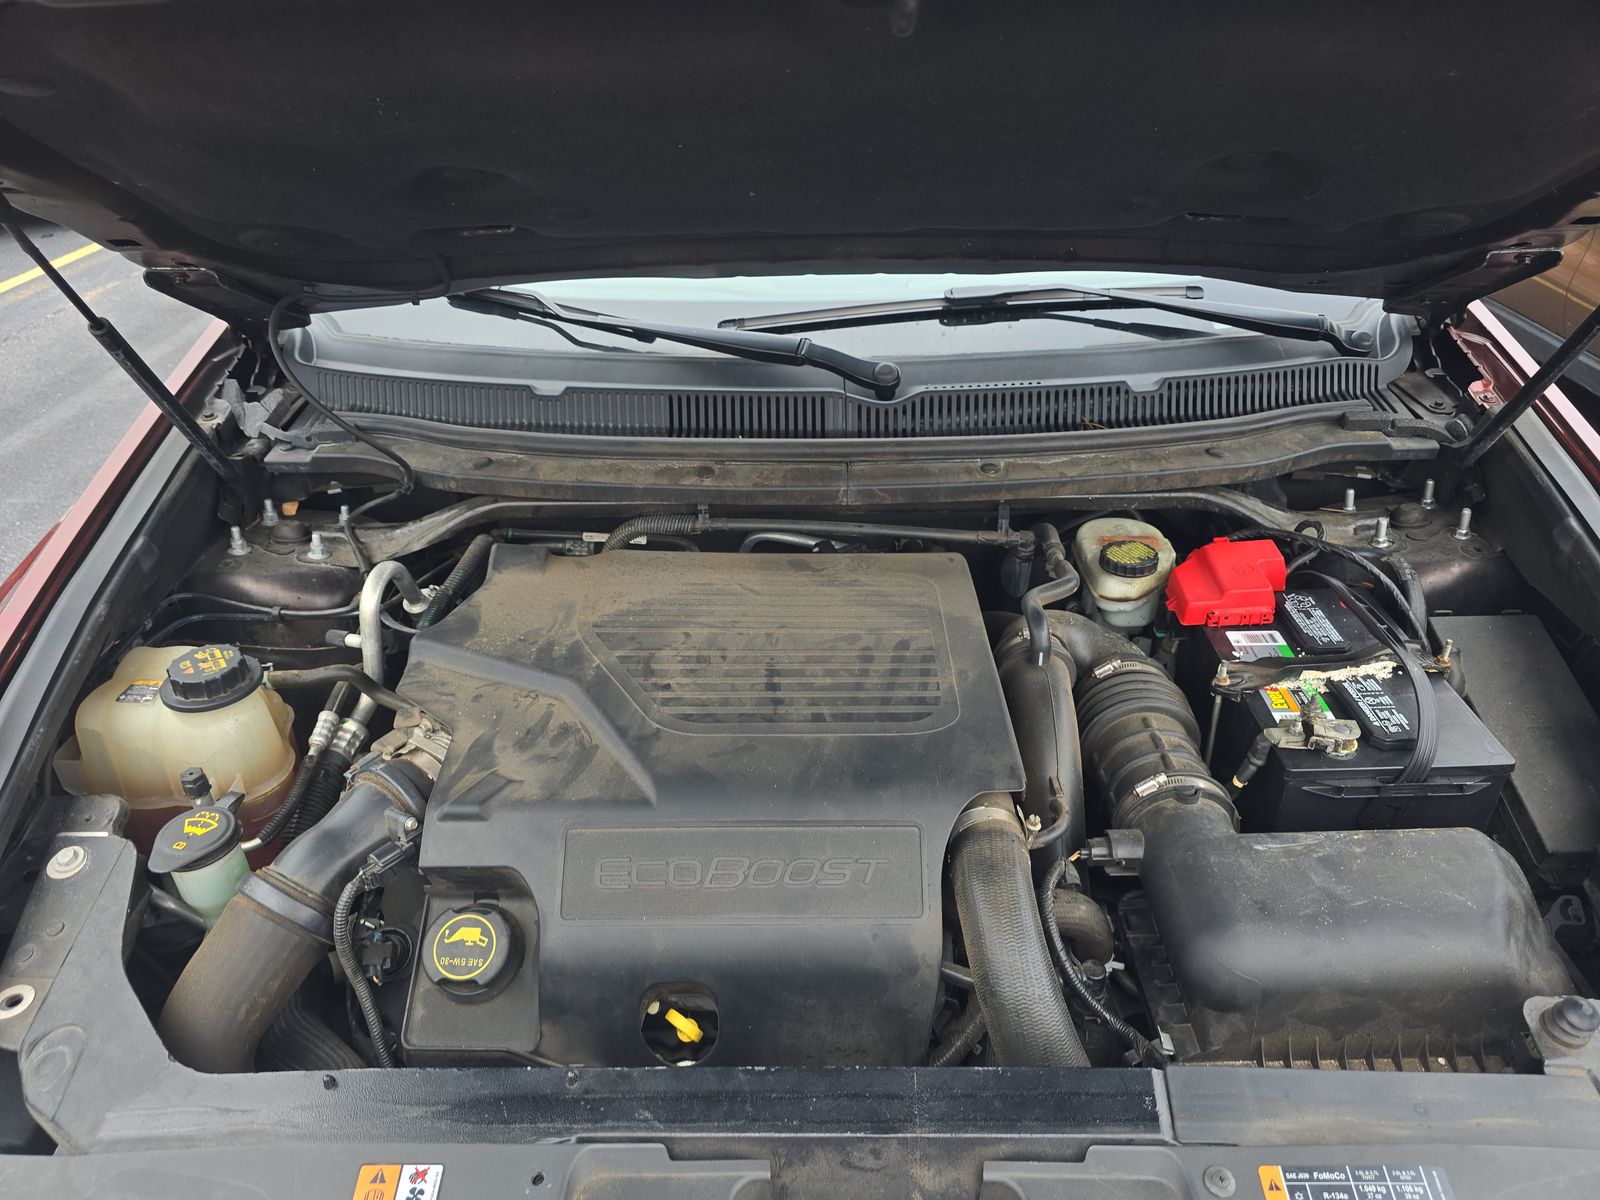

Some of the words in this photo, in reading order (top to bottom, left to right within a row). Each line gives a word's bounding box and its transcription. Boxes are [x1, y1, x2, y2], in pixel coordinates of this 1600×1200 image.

[440, 956, 466, 966] 5W-30
[467, 958, 484, 967] SAE
[1313, 1171, 1346, 1180] FoMoCo
[1376, 1185, 1387, 1194] kg
[1414, 1185, 1424, 1194] kg
[1323, 1191, 1349, 1200] R-134a
